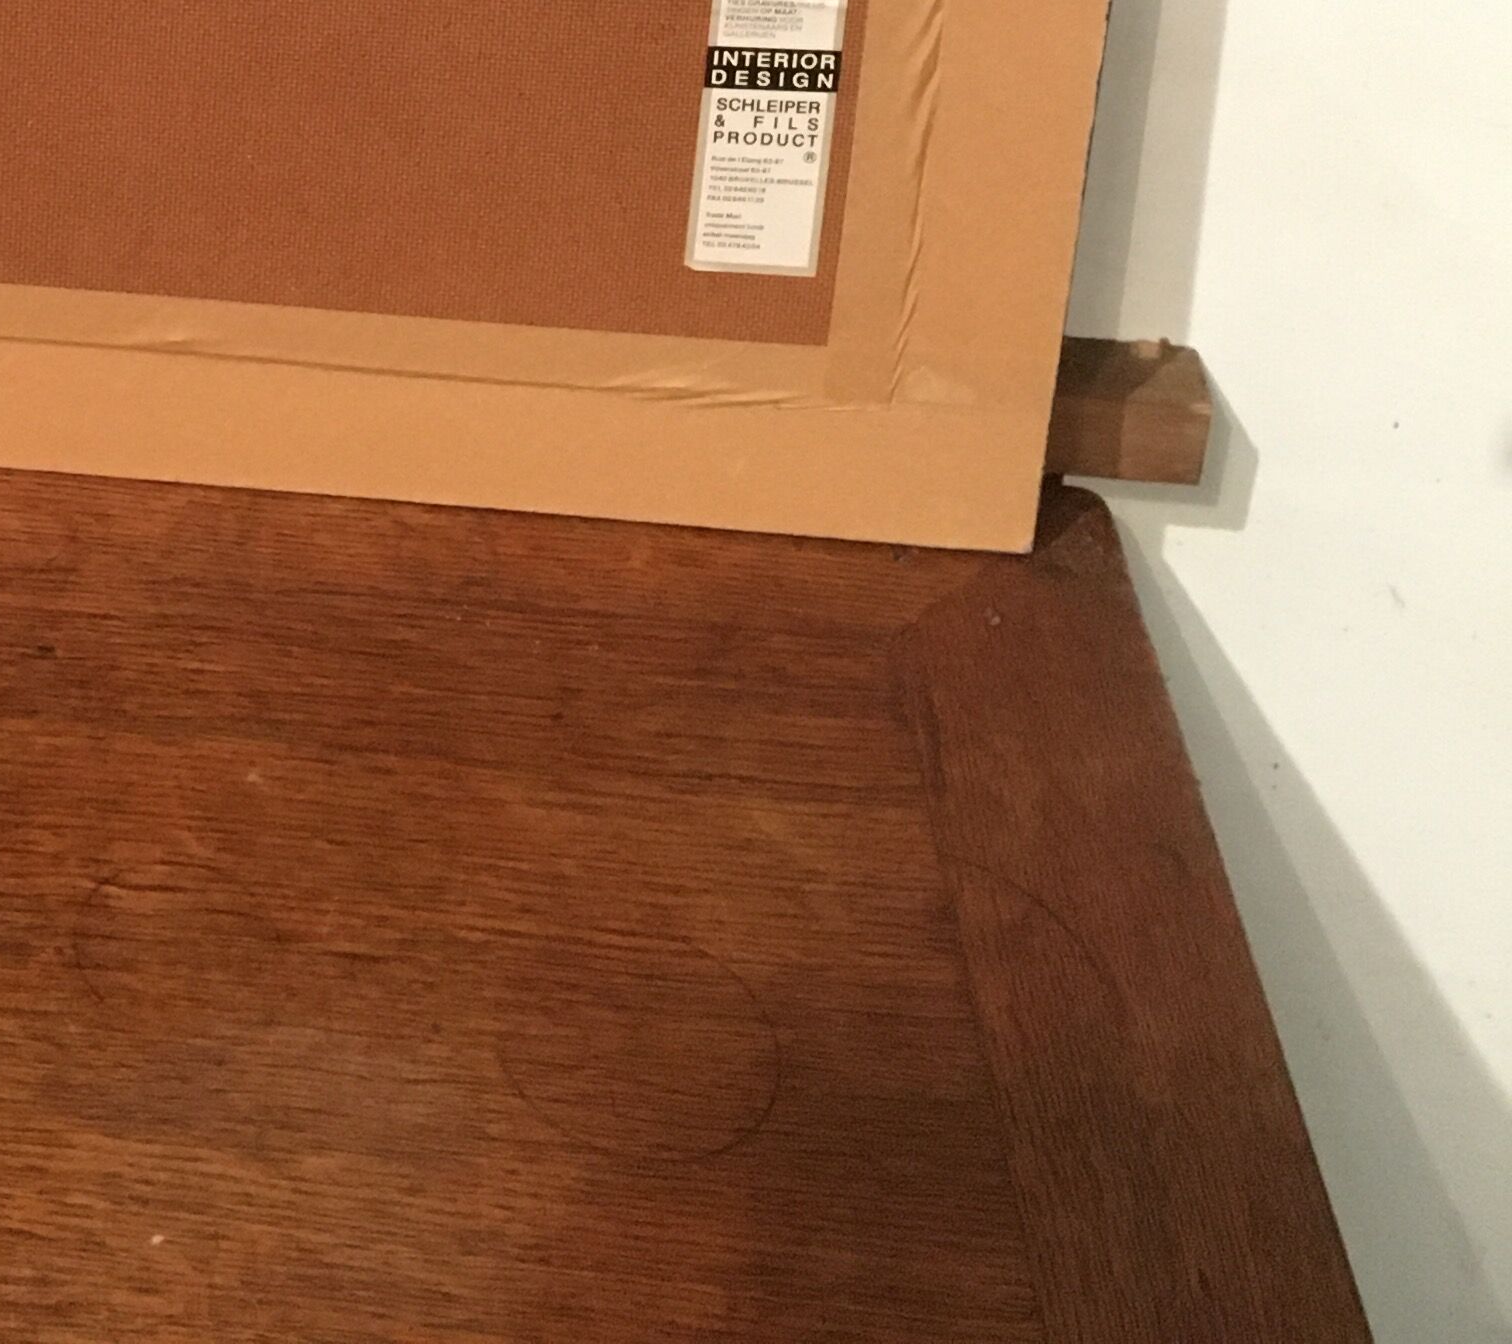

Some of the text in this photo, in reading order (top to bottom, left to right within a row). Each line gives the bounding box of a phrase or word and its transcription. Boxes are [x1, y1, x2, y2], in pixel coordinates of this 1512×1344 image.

[712, 50, 837, 71] INTERIOR
[710, 69, 835, 89] DESIGN
[716, 97, 821, 115] SCHLEIPER
[714, 114, 820, 132] & FILS
[712, 131, 819, 148] PRODUCT
